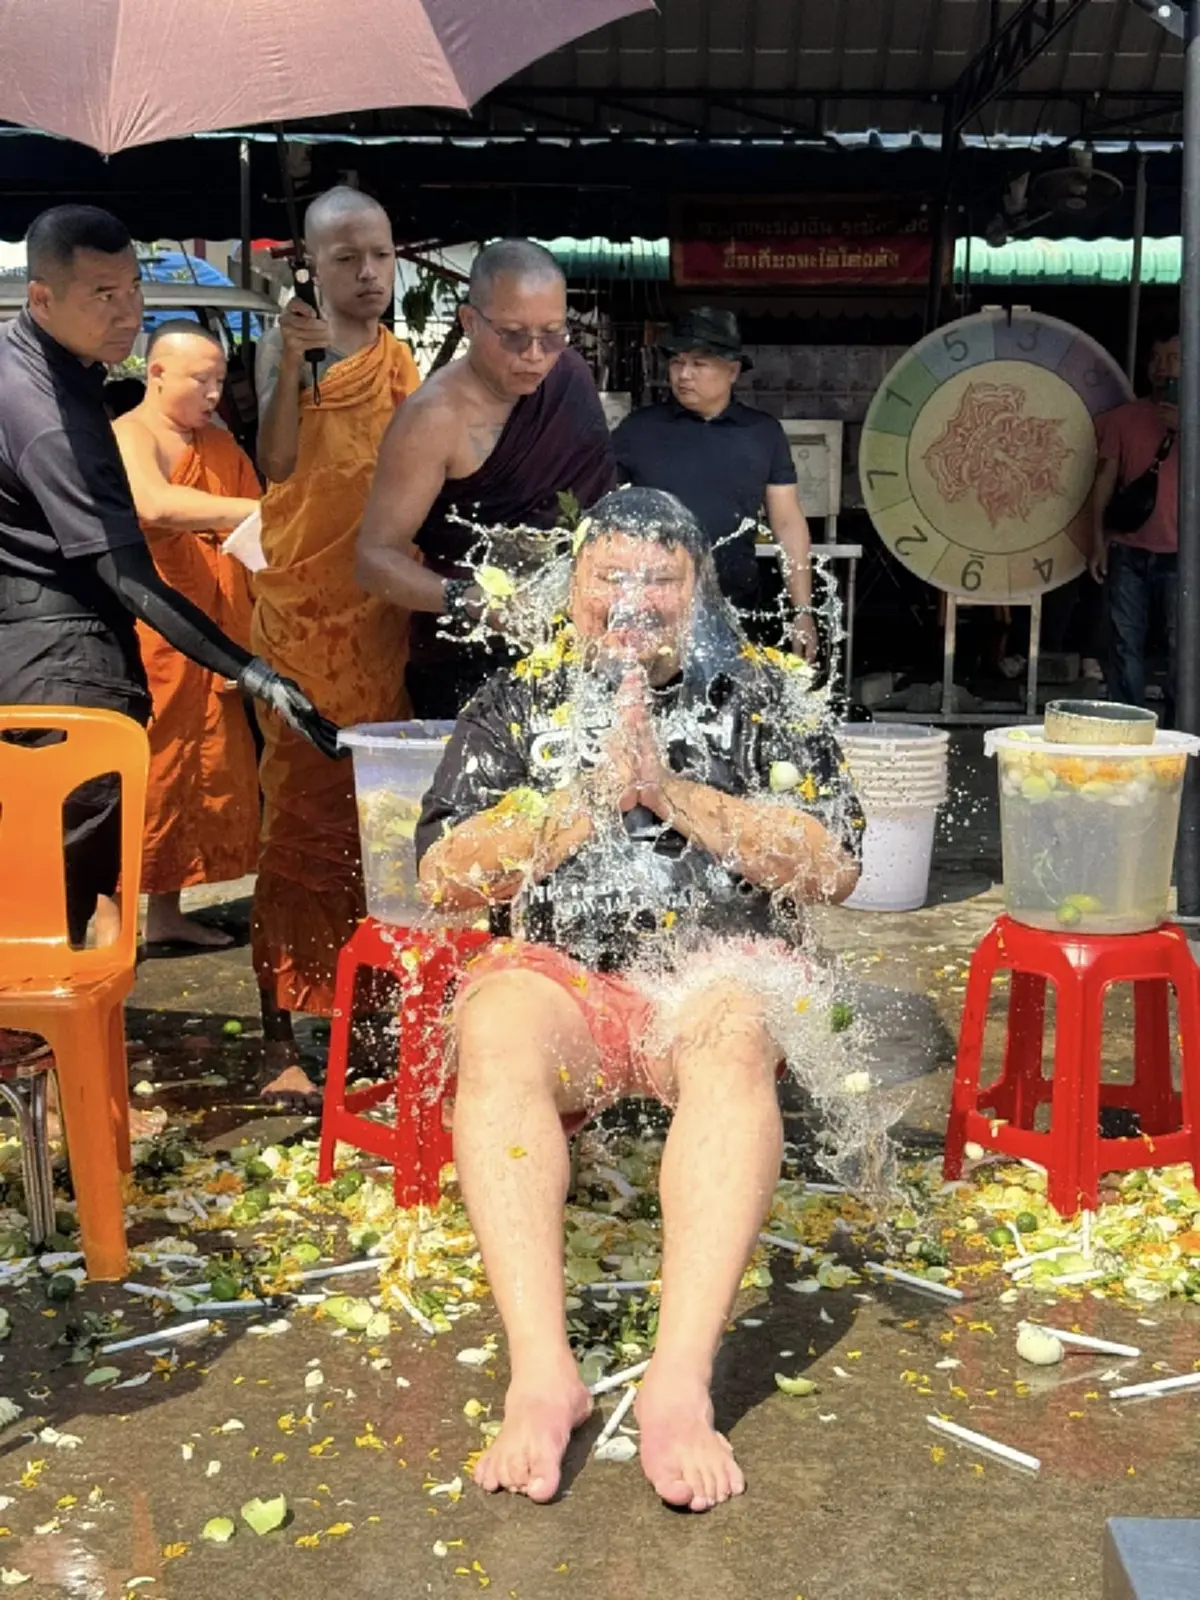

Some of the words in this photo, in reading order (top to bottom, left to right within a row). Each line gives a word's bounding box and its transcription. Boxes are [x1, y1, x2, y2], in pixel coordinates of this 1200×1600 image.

[942, 330, 969, 361] 5
[1016, 322, 1041, 352] 3
[885, 388, 913, 408] 1
[866, 469, 898, 490] 7
[894, 525, 928, 556] 2
[1032, 557, 1053, 584] 4
